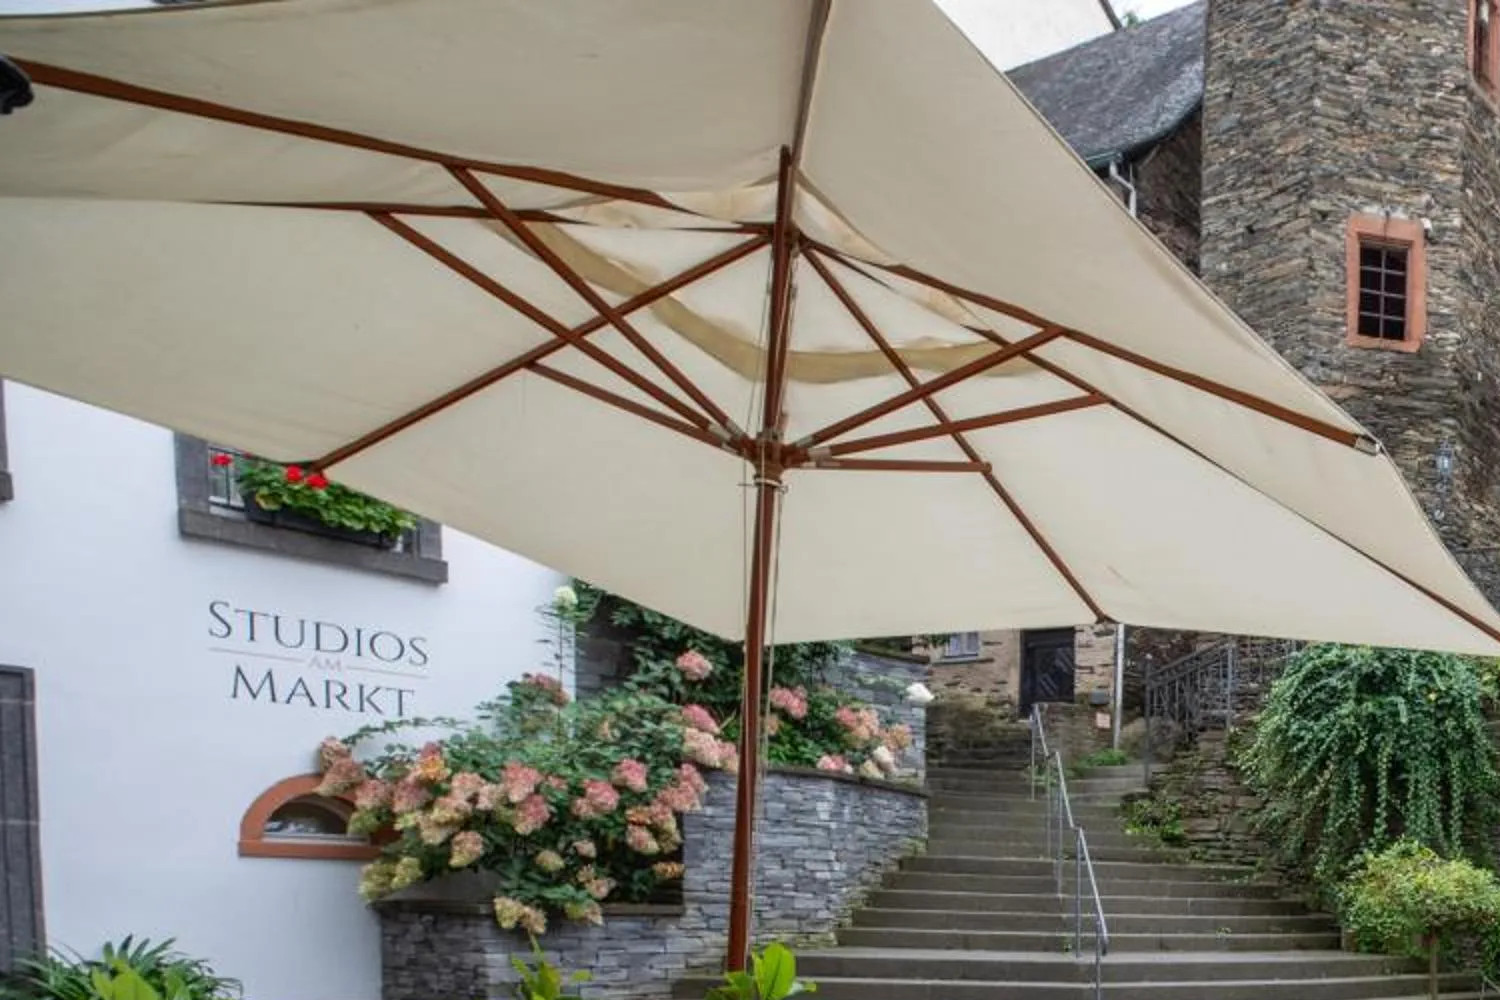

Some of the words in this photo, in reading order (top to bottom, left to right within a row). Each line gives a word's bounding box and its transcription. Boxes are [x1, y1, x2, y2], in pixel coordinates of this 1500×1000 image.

[208, 600, 429, 667] STUDIOS
[307, 654, 342, 673] AM
[231, 665, 415, 718] MARKT
